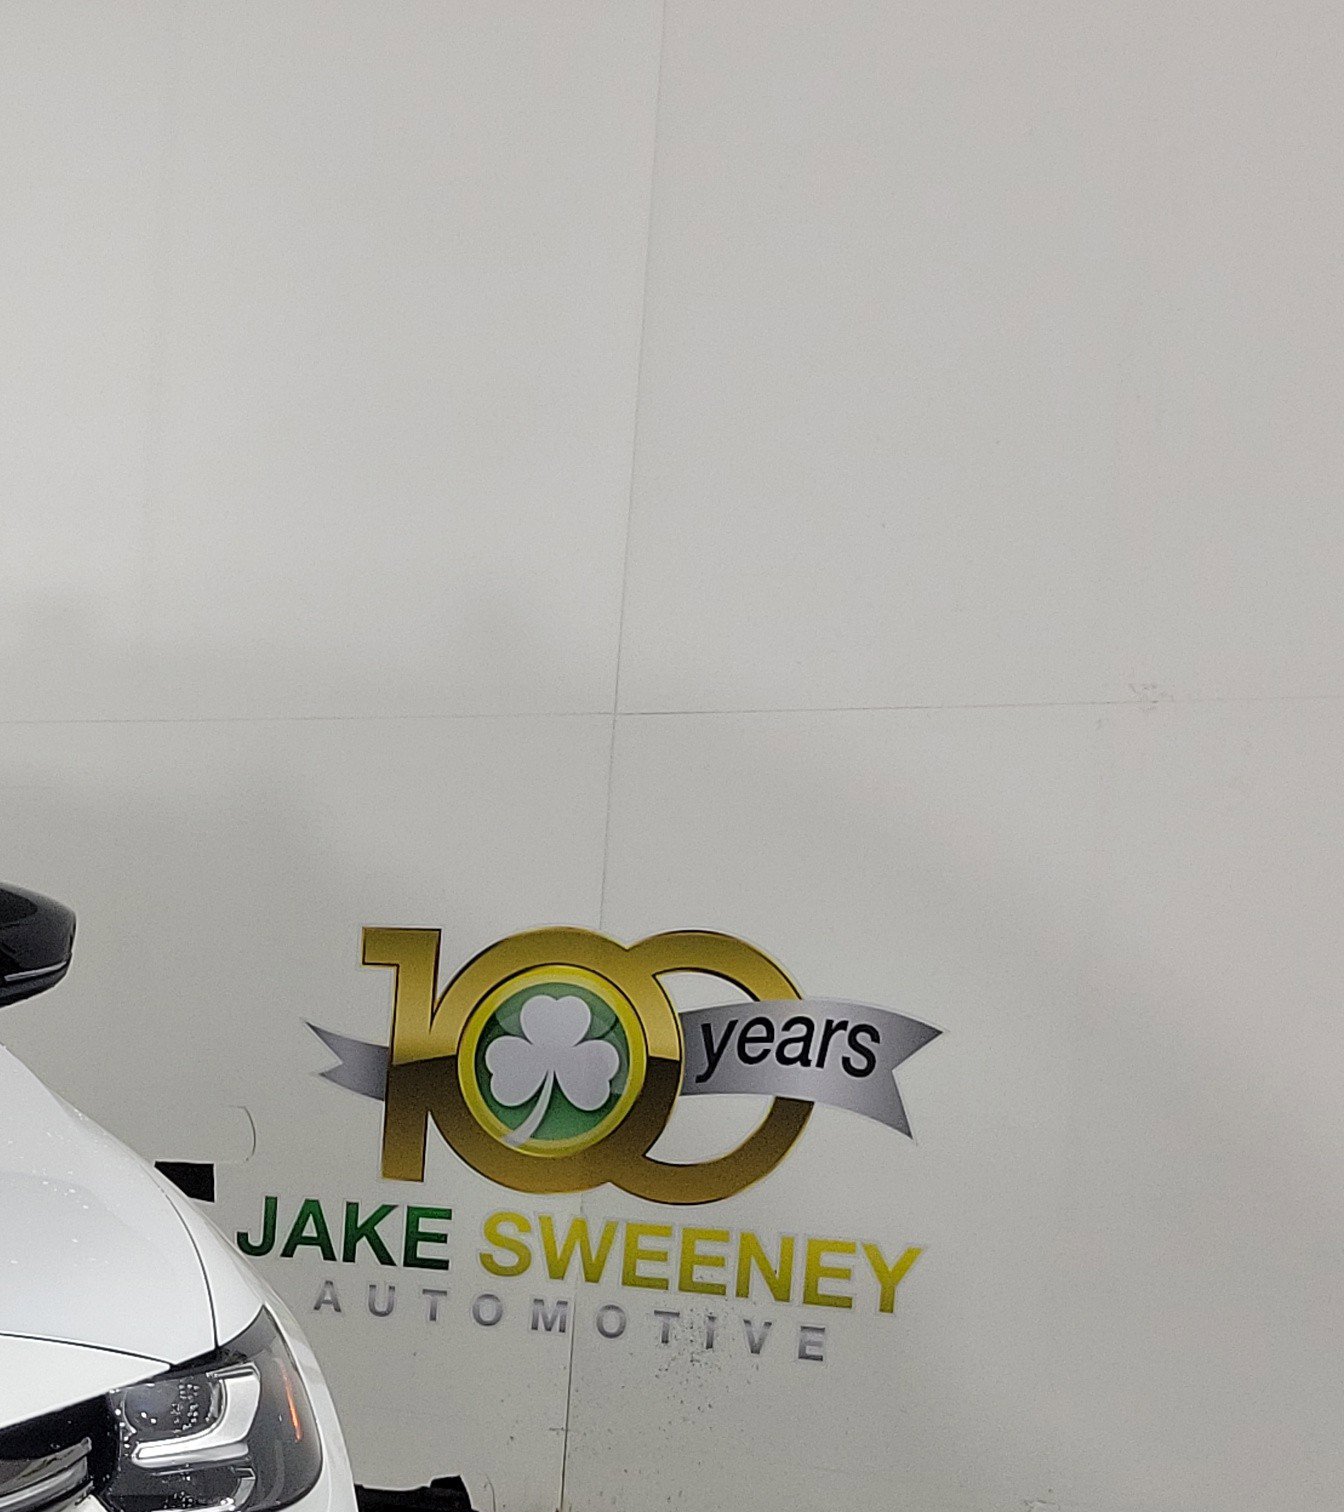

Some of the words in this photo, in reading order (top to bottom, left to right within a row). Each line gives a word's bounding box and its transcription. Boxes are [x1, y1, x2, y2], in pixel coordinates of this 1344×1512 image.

[362, 926, 815, 1205] 100
[694, 1014, 882, 1085] years
[236, 1196, 453, 1271] JAKE
[478, 1210, 923, 1314] SWEENEY
[313, 1279, 826, 1362] AUTOMOTIVE
